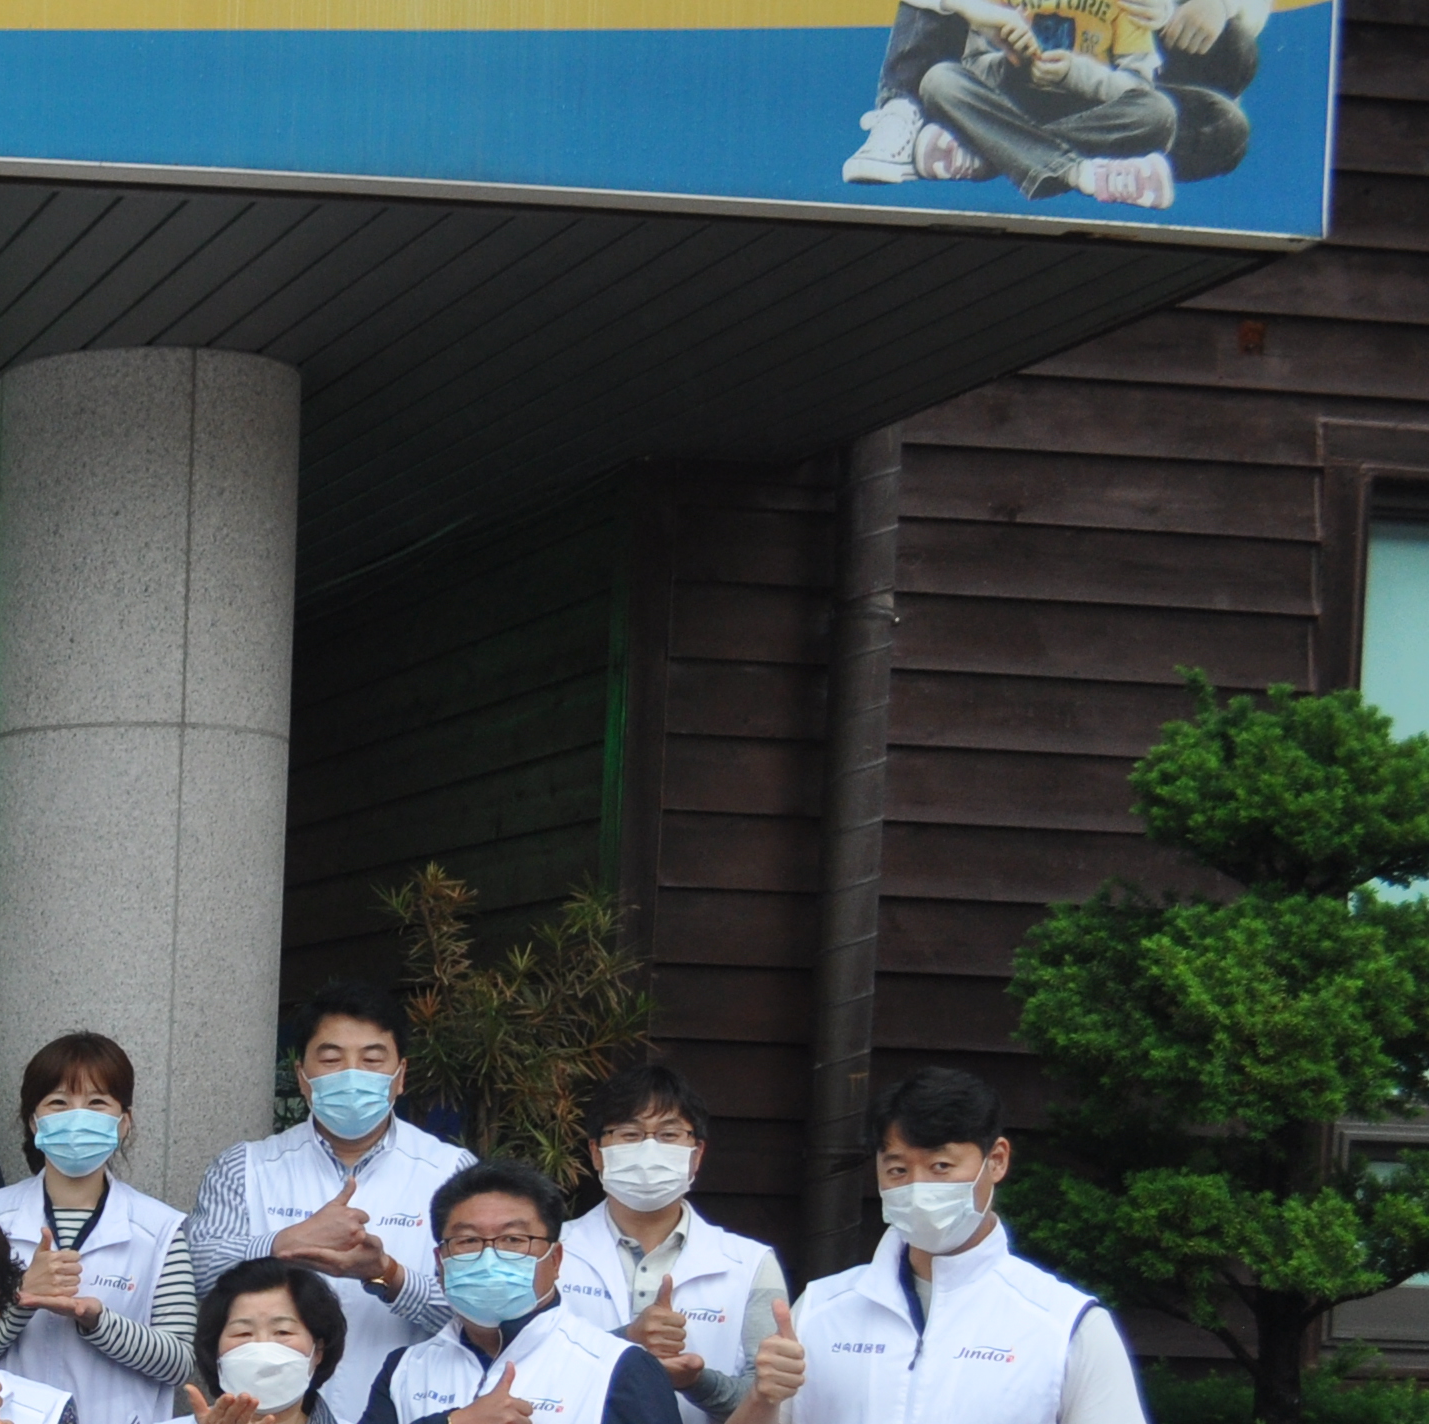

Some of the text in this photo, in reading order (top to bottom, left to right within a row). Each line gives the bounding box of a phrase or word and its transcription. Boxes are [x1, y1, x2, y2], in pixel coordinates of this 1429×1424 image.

[376, 1216, 415, 1228] Jindo
[89, 1275, 128, 1291] Jindo
[831, 1342, 886, 1354] 신속대응팀
[953, 1346, 1005, 1363] Jindo
